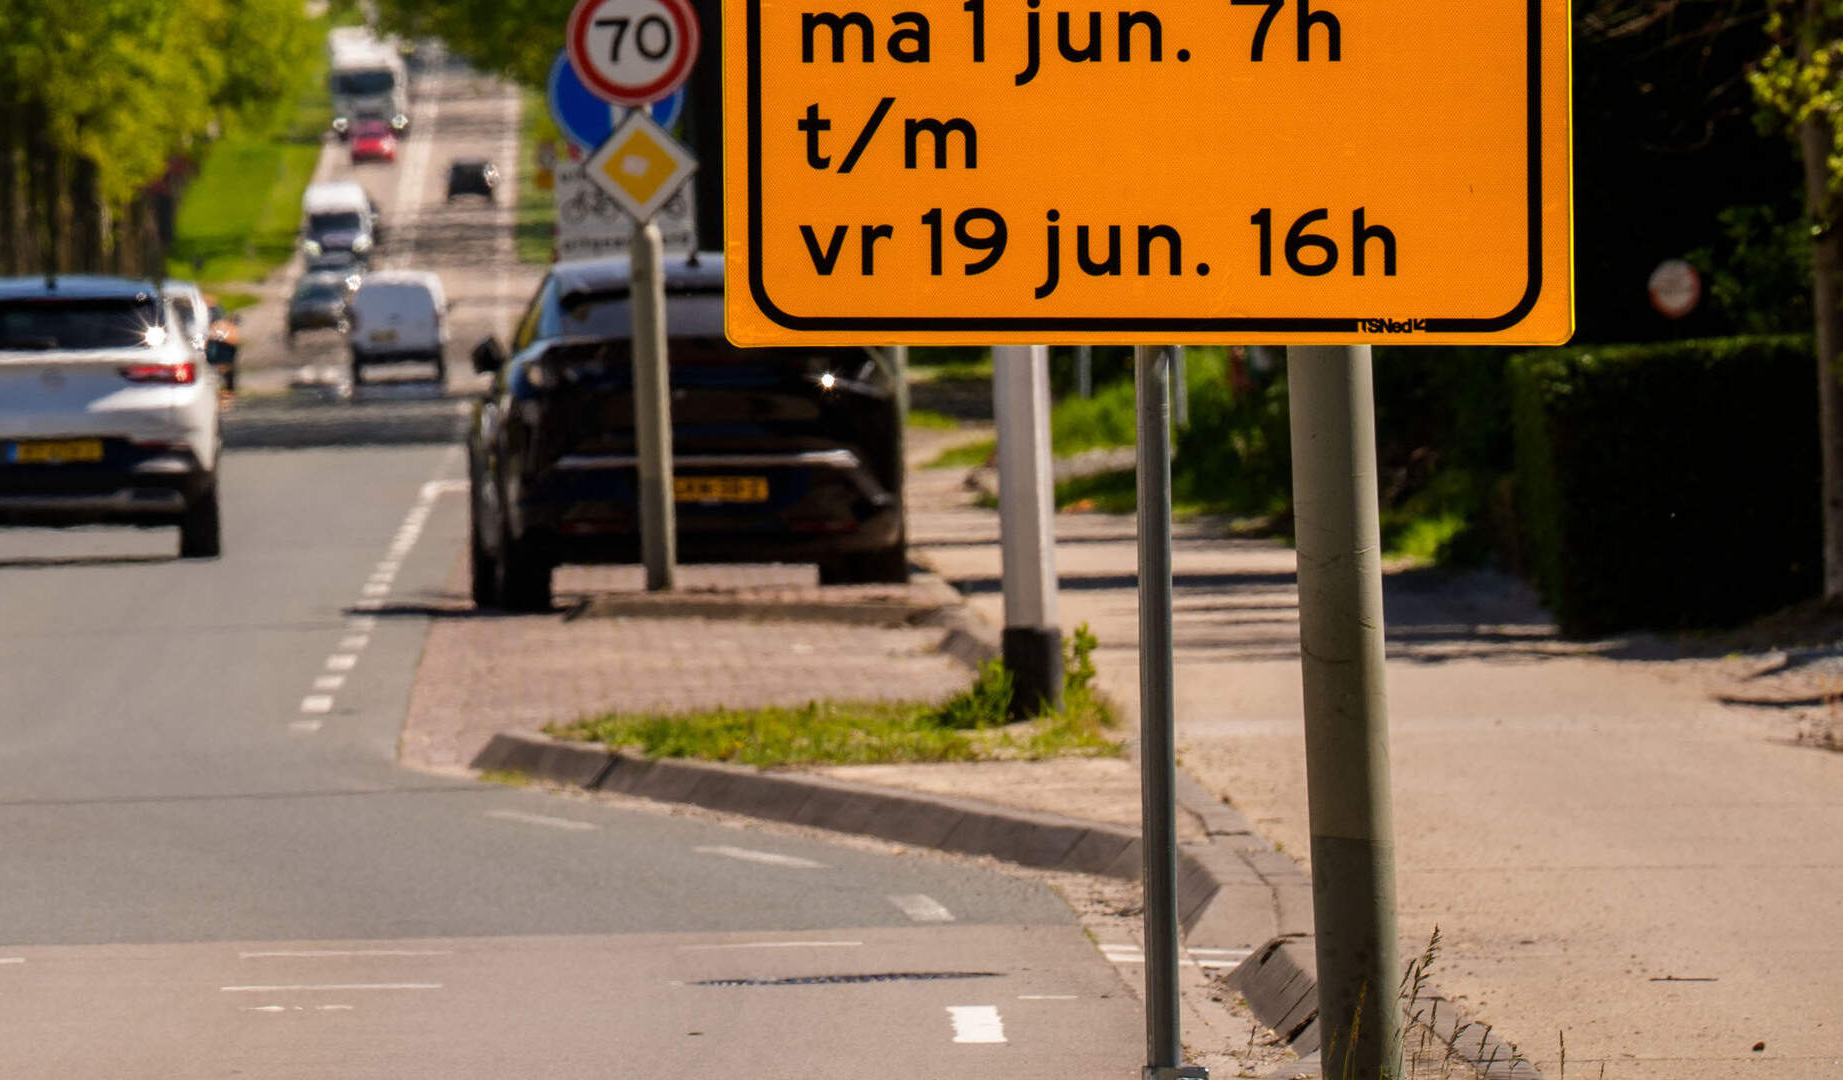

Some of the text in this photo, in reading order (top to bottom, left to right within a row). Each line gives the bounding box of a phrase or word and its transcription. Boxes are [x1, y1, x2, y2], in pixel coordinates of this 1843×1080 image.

[593, 13, 673, 64] 70
[801, 11, 931, 64] ma
[797, 97, 978, 174] t/m
[799, 206, 1397, 300] vr 19 jun. 16h
